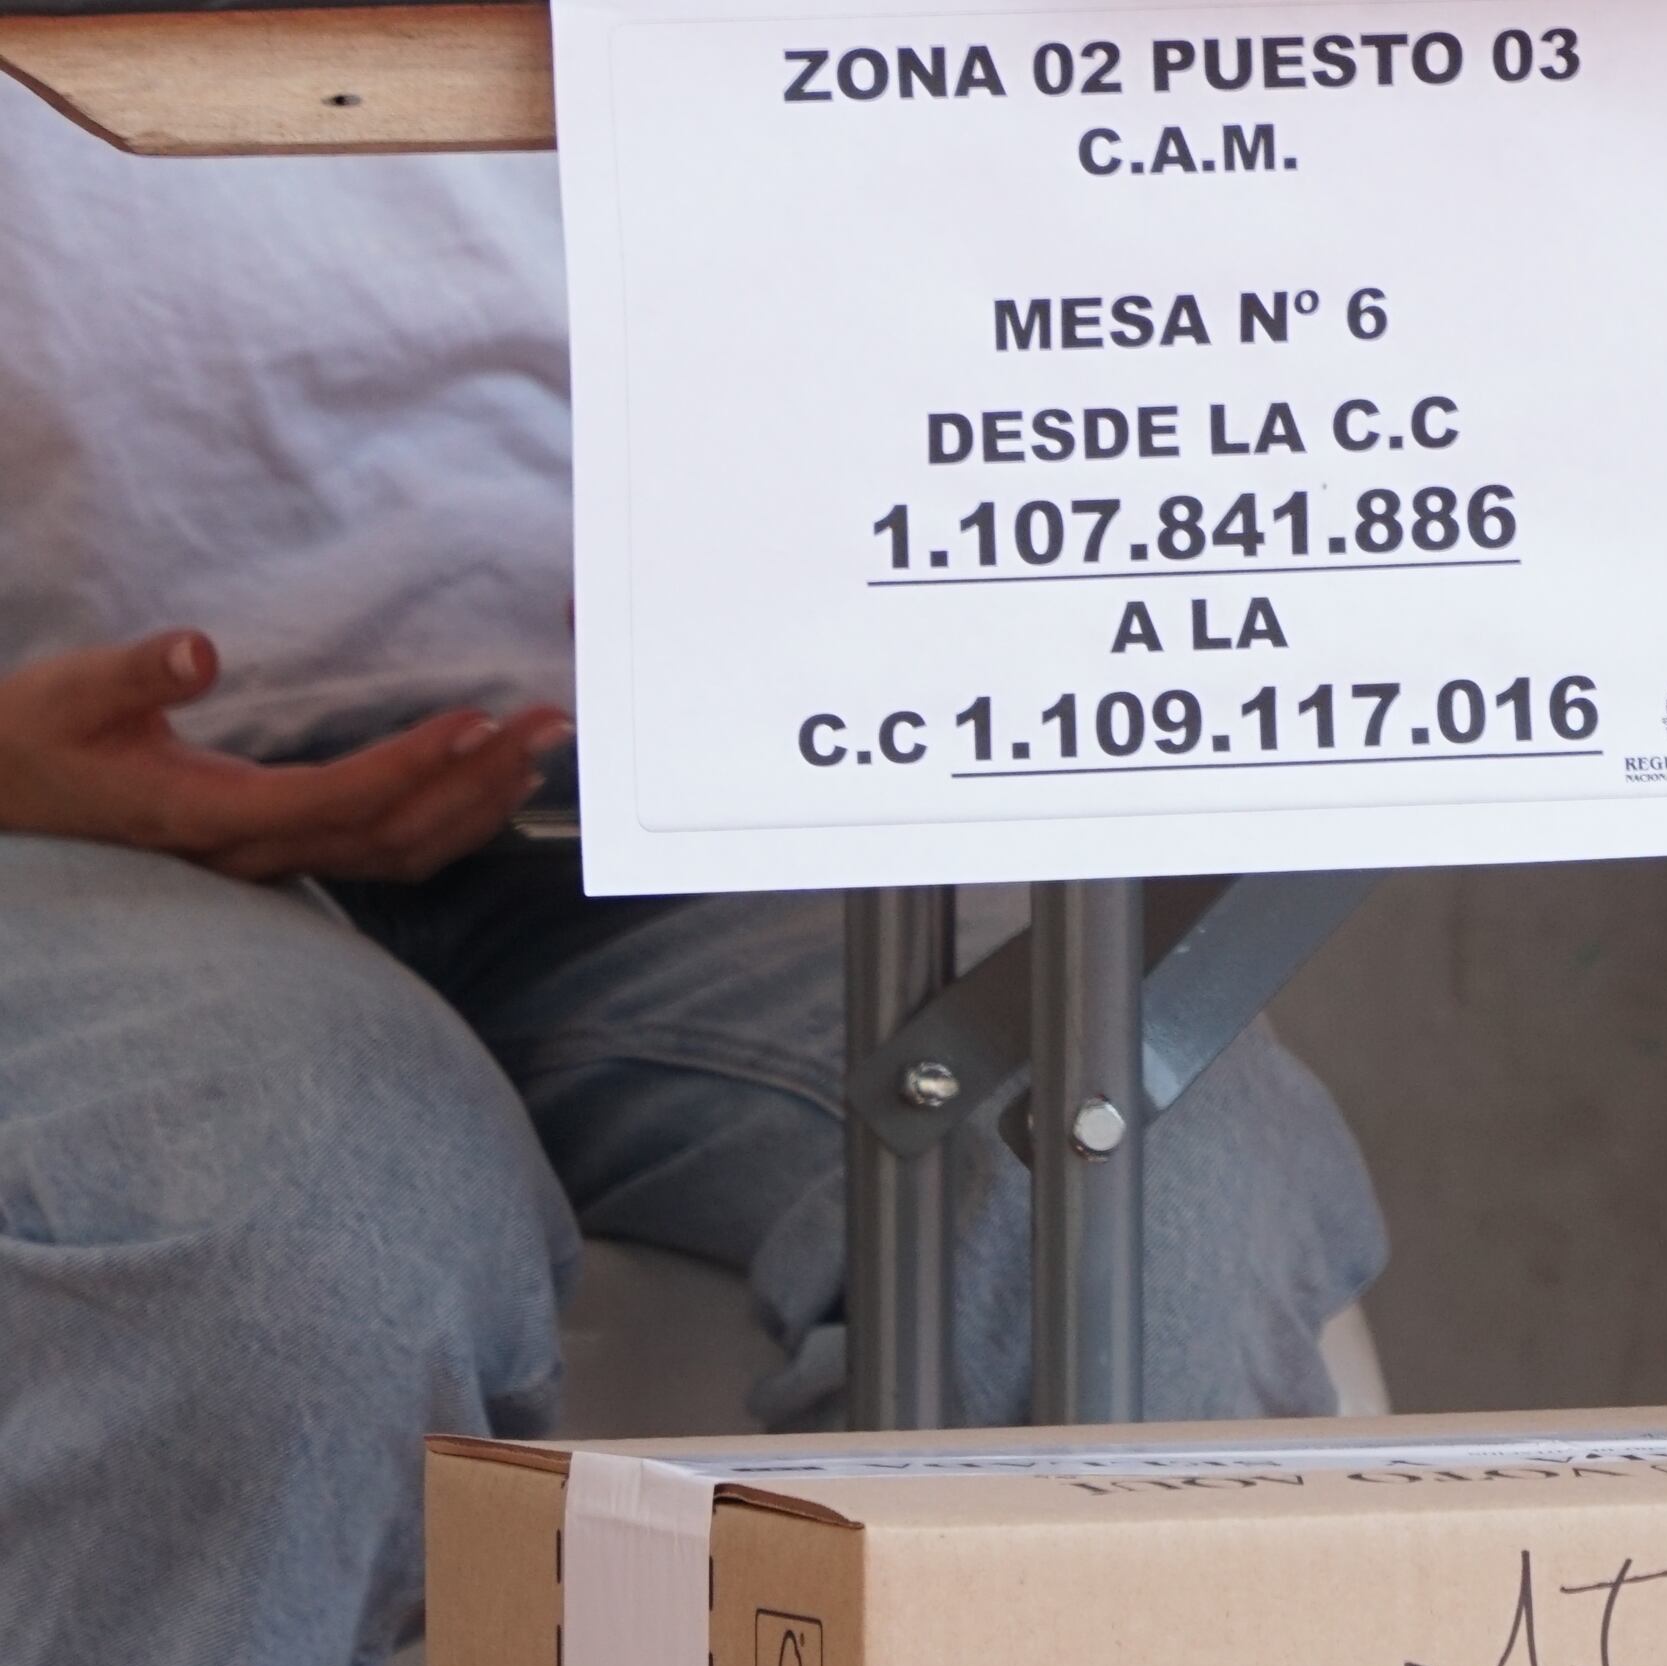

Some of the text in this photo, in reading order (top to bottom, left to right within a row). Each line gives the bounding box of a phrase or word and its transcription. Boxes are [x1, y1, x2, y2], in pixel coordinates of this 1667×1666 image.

[784, 27, 1581, 102] ZONA 02 PUESTO 03
[1077, 125, 1299, 176] C.A.M.
[995, 296, 1210, 352] MESA
[1347, 286, 1388, 340] 6
[927, 396, 1460, 465] DESDE LA C.C
[872, 485, 1517, 573] 1.107.841.886
[1112, 598, 1288, 654] A LA
[800, 676, 1600, 767] C.C 1.109.117.016
[1348, 1467, 1627, 1484] VOTO
